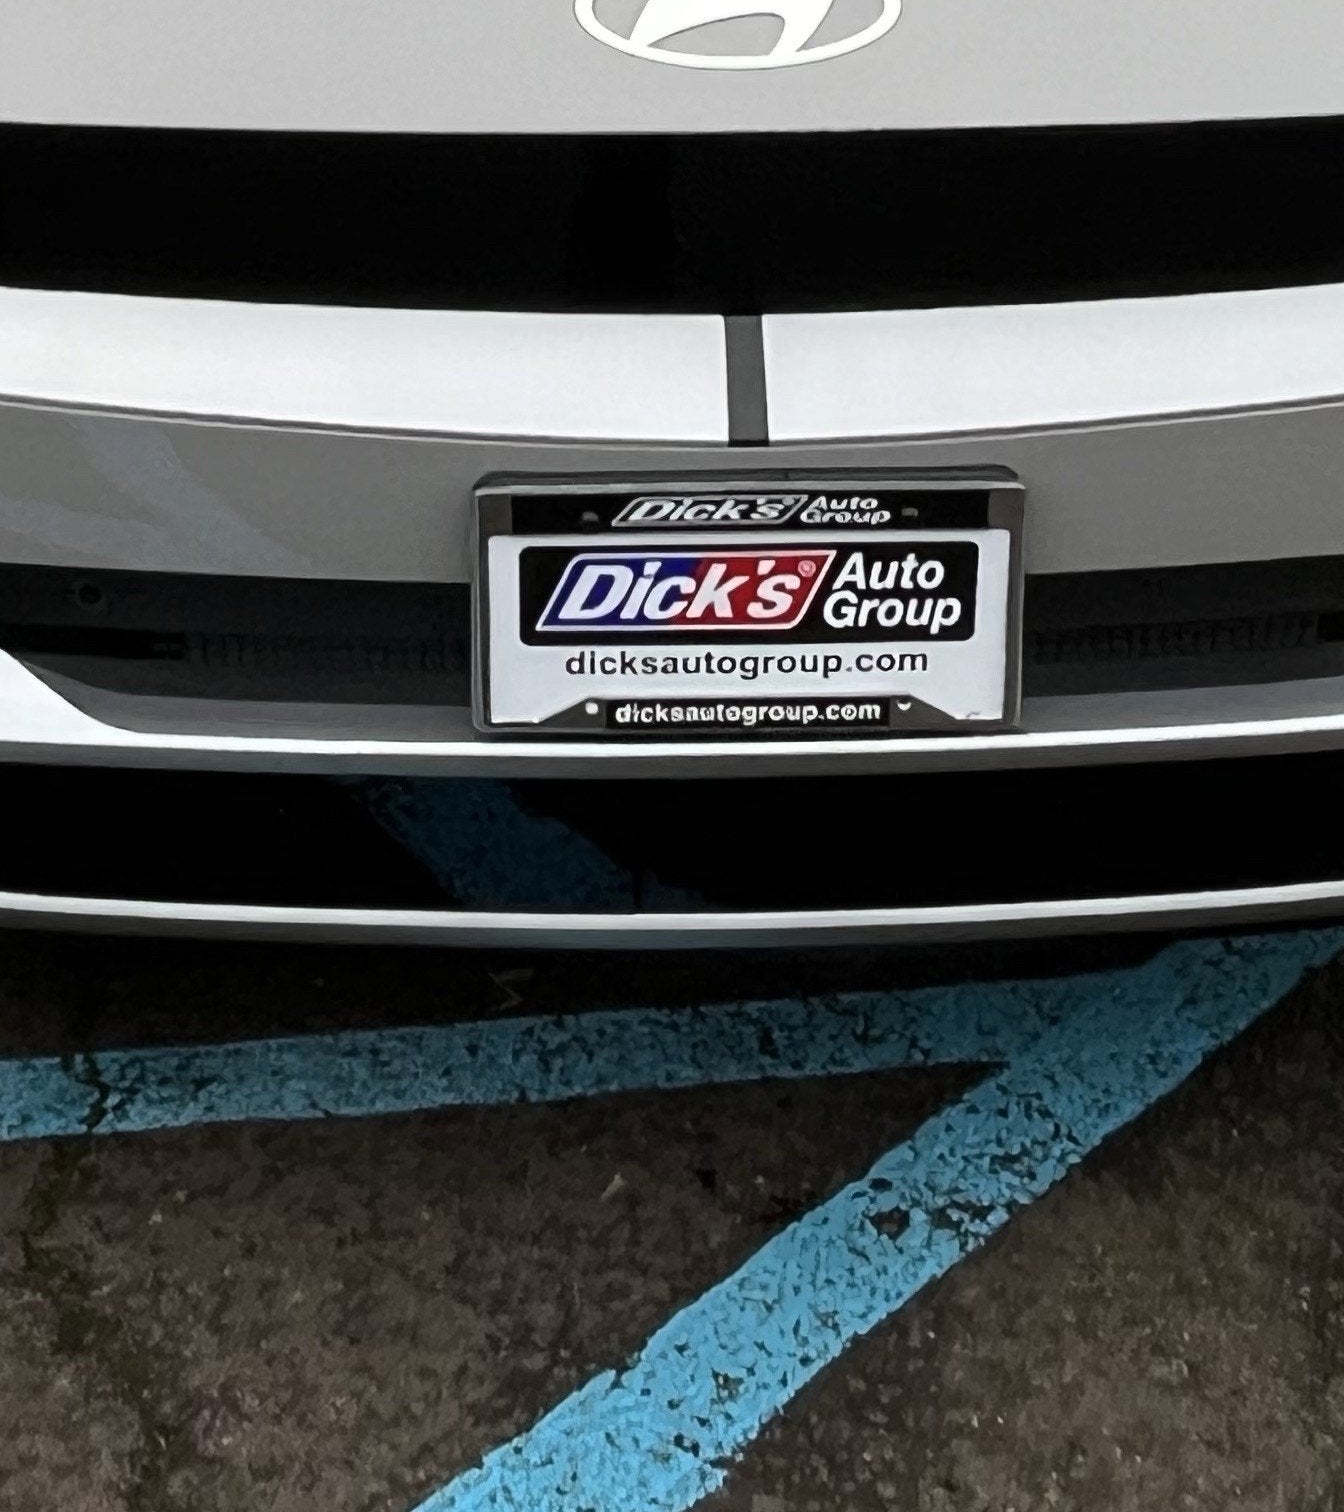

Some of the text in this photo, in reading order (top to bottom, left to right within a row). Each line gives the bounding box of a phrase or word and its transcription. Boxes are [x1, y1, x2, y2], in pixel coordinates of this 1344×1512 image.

[628, 495, 879, 521] Dick's Auto
[799, 508, 892, 525] Group
[557, 552, 945, 619] Dick's Auto
[822, 590, 962, 635] Group
[564, 650, 928, 678] dicksautogroup.com
[615, 702, 881, 726] dicksautogroup.com
